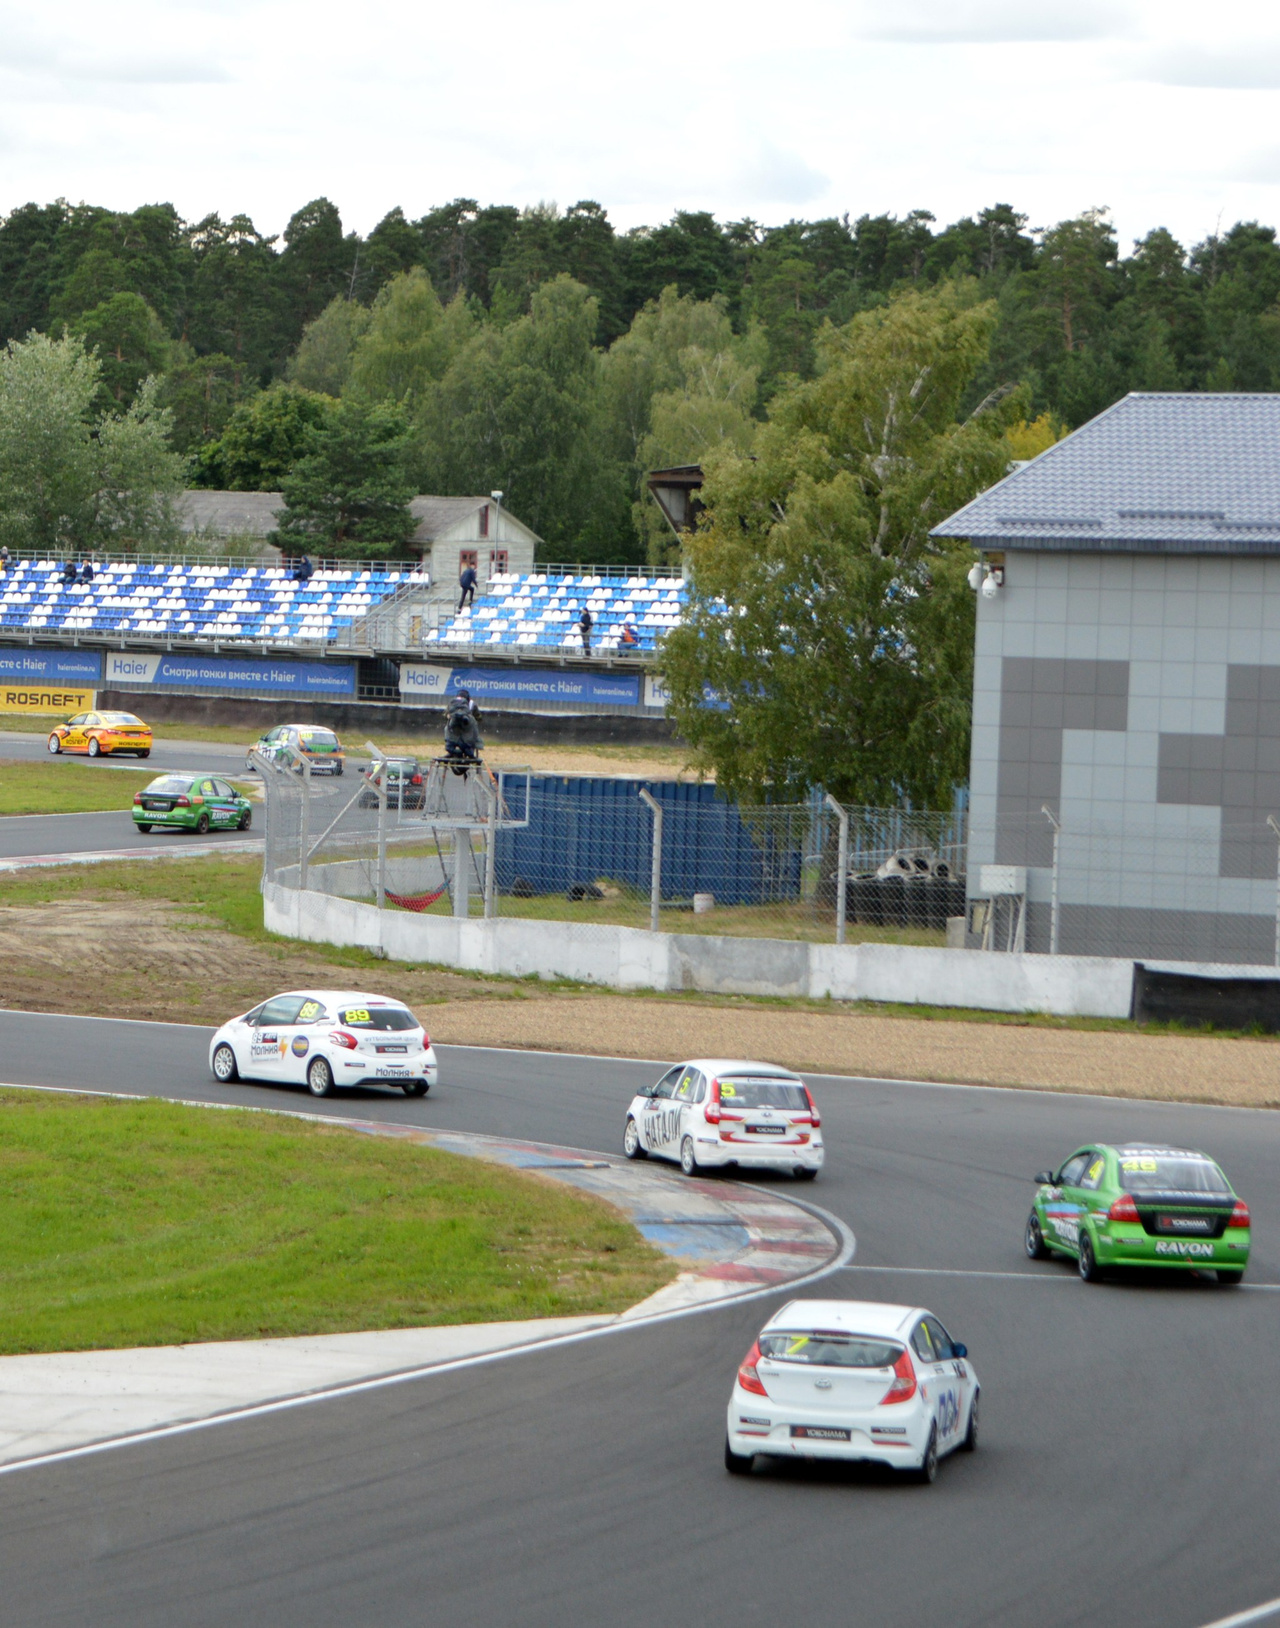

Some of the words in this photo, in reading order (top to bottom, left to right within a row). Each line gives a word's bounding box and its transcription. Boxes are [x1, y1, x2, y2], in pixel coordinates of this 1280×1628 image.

[23, 657, 46, 670] Haier
[113, 659, 148, 674] Haier
[162, 664, 198, 679] Смотри
[199, 669, 227, 679] гонки
[270, 669, 296, 683] Haier
[406, 670, 439, 686] Haier
[453, 676, 488, 692] Смотри
[489, 680, 516, 690] гонки
[557, 680, 583, 694] Haier
[5, 692, 86, 707] ROSNEFT
[211, 811, 231, 820] RAVON
[300, 1002, 319, 1018] 89
[345, 1009, 370, 1022] 89
[680, 1077, 691, 1094] 5
[720, 1082, 736, 1097] 5
[1122, 1160, 1157, 1172] 46
[1171, 1219, 1208, 1229] YOKOHAMA
[1155, 1241, 1214, 1257] RAVON
[786, 1336, 809, 1354] 7
[806, 1429, 847, 1439] YOKOHAMA
